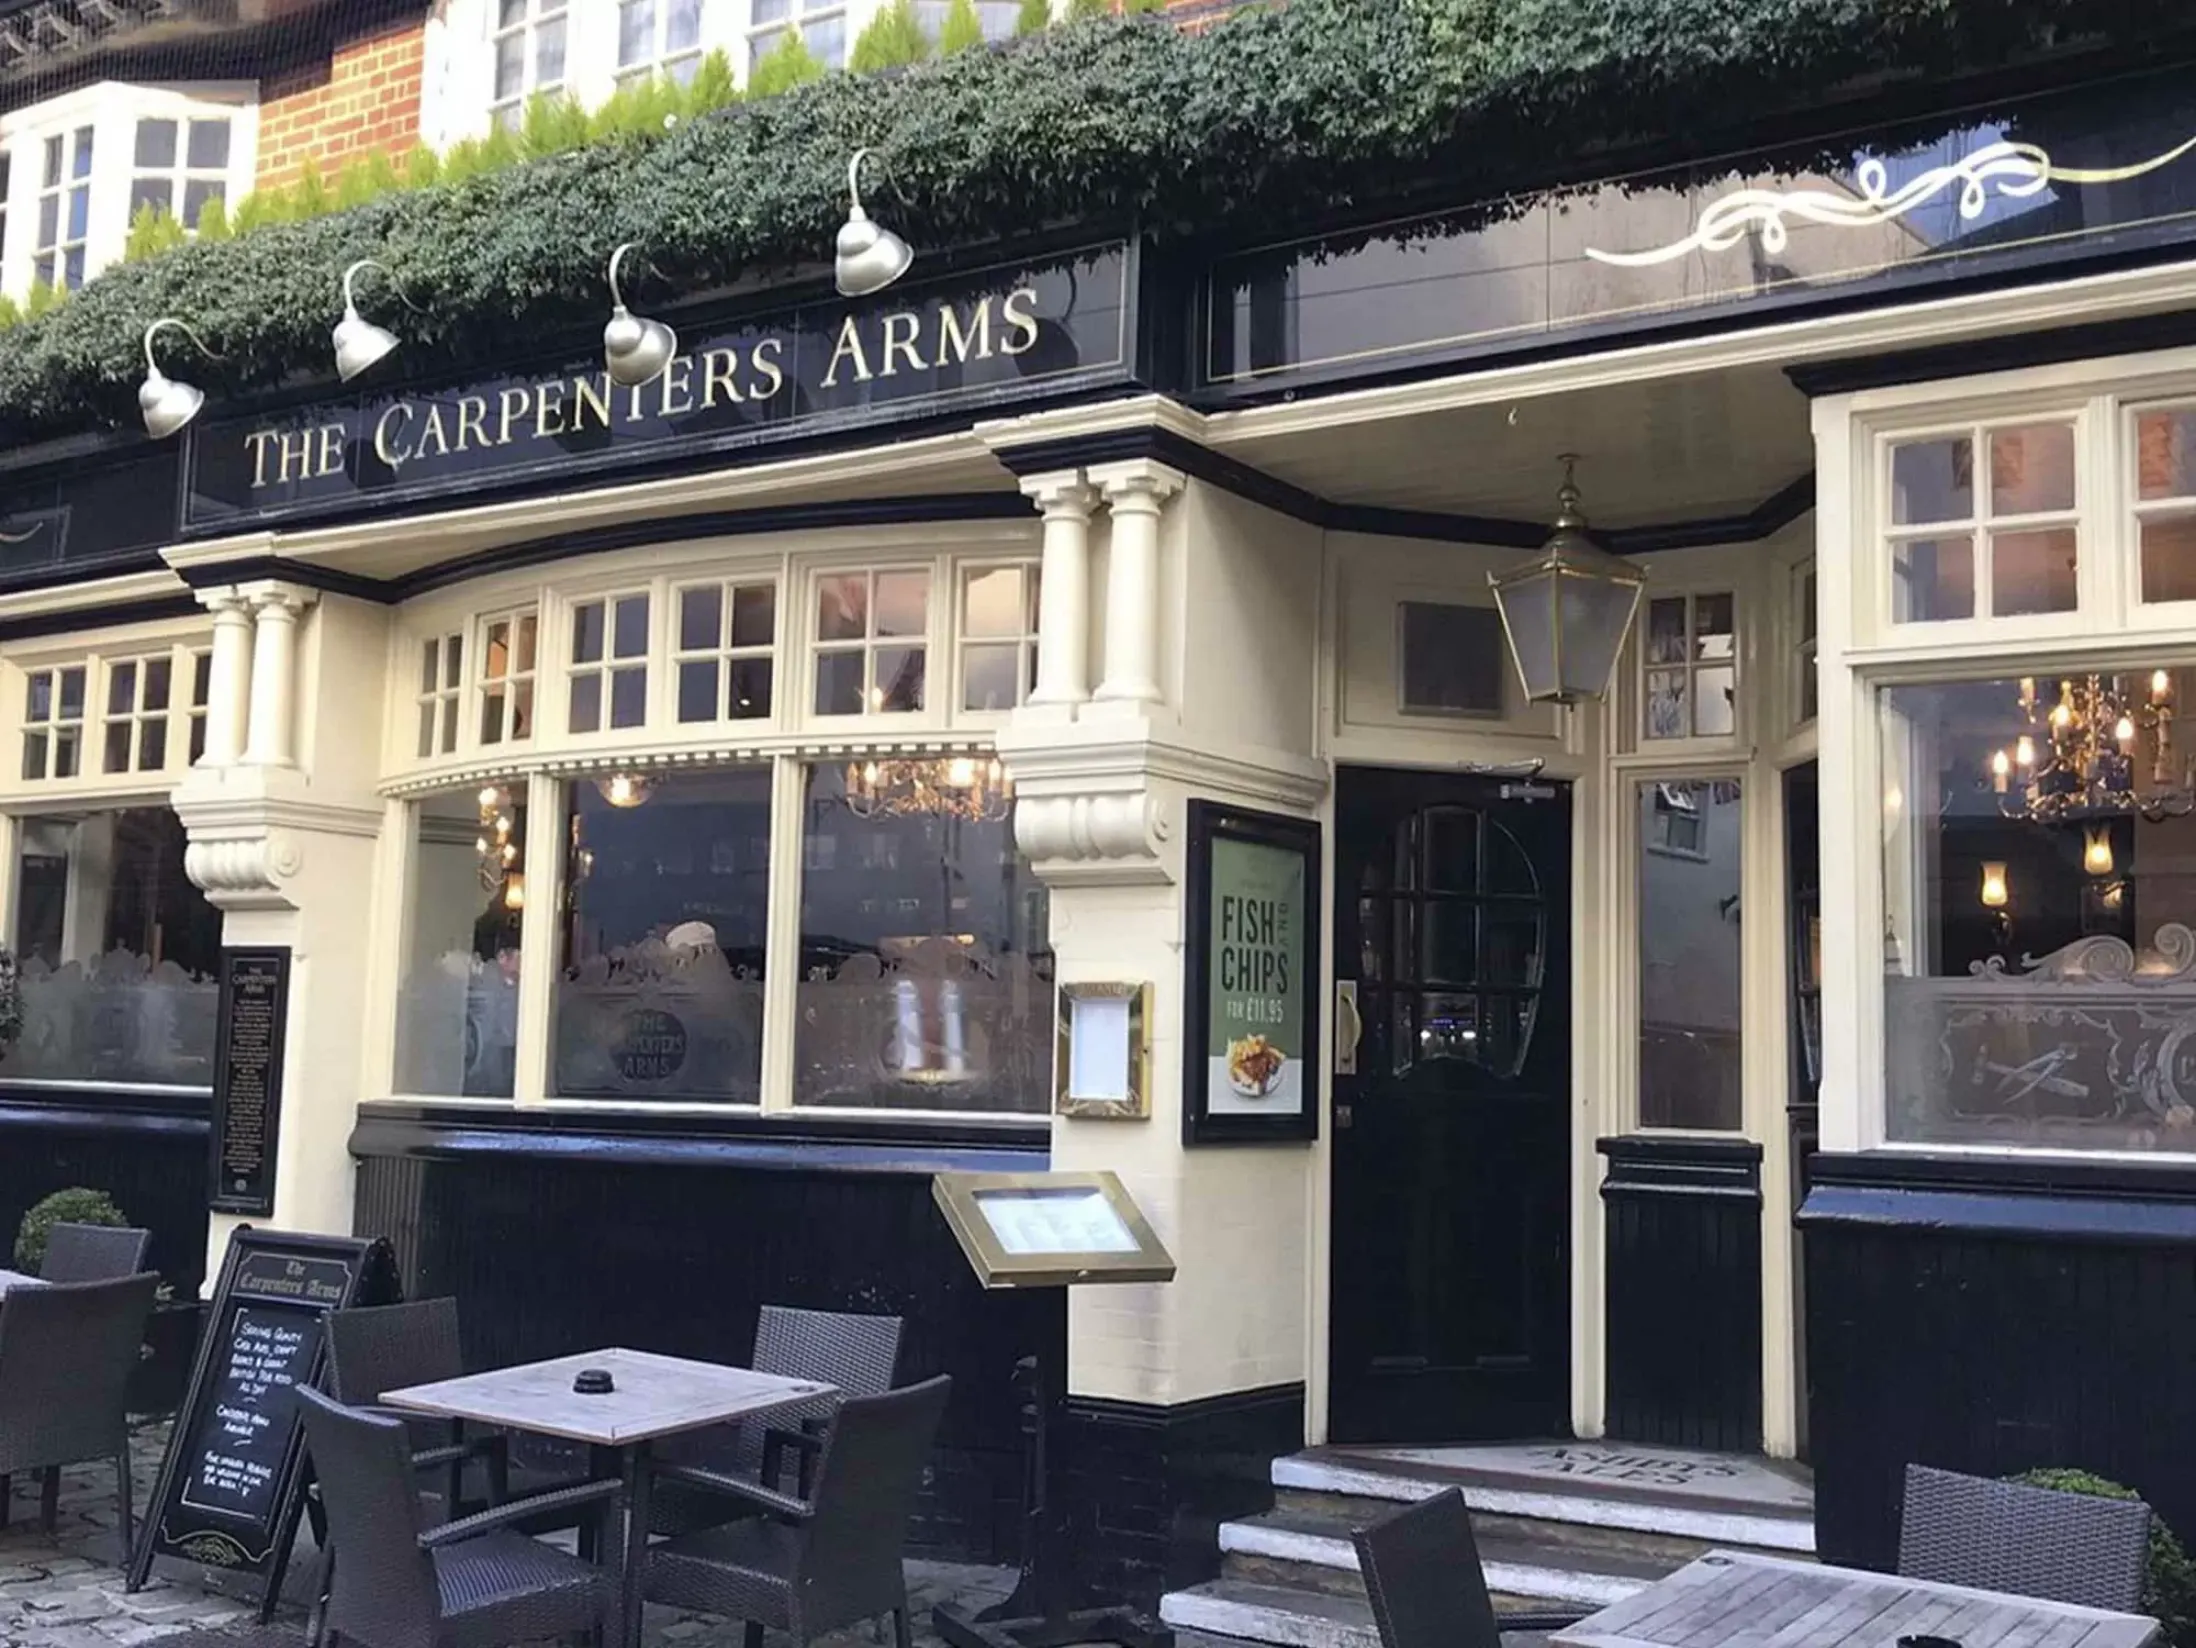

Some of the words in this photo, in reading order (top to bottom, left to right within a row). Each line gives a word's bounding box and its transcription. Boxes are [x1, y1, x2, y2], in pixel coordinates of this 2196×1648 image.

[244, 421, 347, 489] THE
[374, 337, 783, 470] CARPENTERS
[819, 288, 1039, 389] ARMS
[1222, 894, 1275, 946] FISH
[1221, 946, 1288, 994] CHIPS
